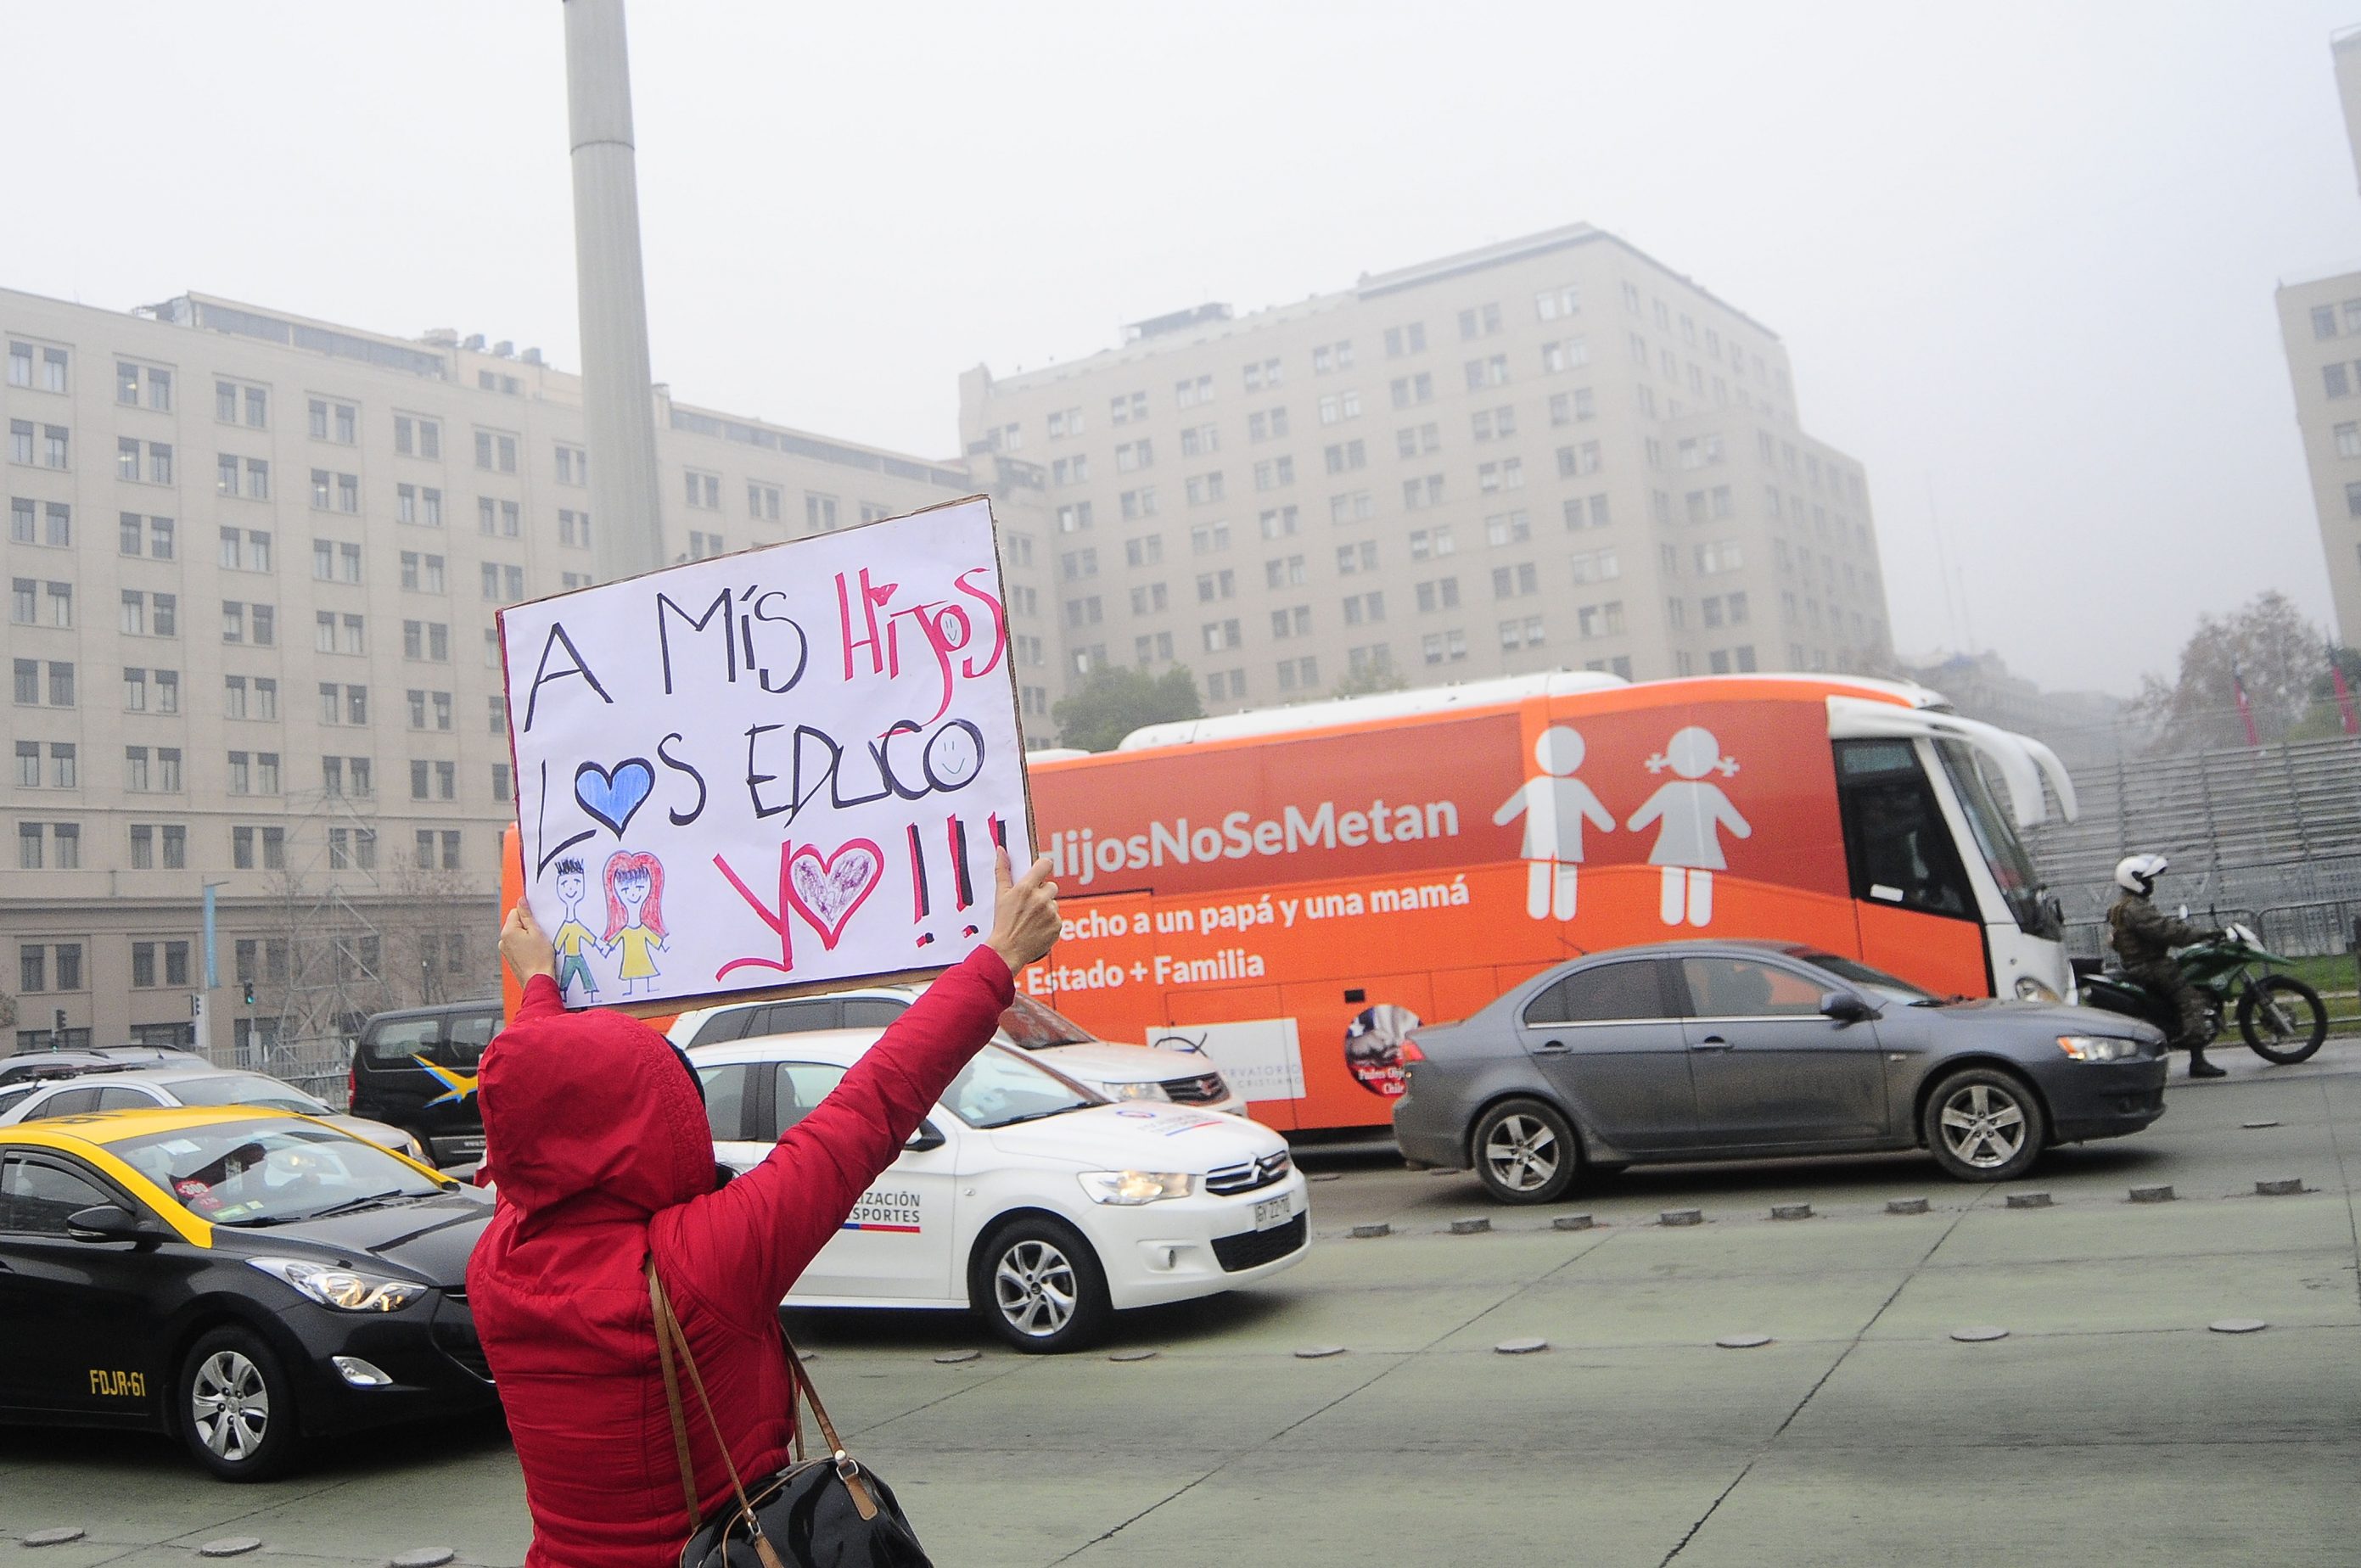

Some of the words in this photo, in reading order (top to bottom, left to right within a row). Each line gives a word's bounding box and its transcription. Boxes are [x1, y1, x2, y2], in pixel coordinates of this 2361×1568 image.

[524, 623, 614, 732] A
[744, 719, 984, 828] EDUCO
[1133, 912, 1150, 934] a
[1156, 910, 1194, 933] un
[1200, 893, 1275, 935] papá
[1280, 899, 1298, 927] y
[1305, 893, 1364, 919] una
[1371, 874, 1470, 913] mamá
[1027, 959, 1124, 995] Estado
[1154, 948, 1265, 984] Familia
[850, 1207, 921, 1223] SPORTES
